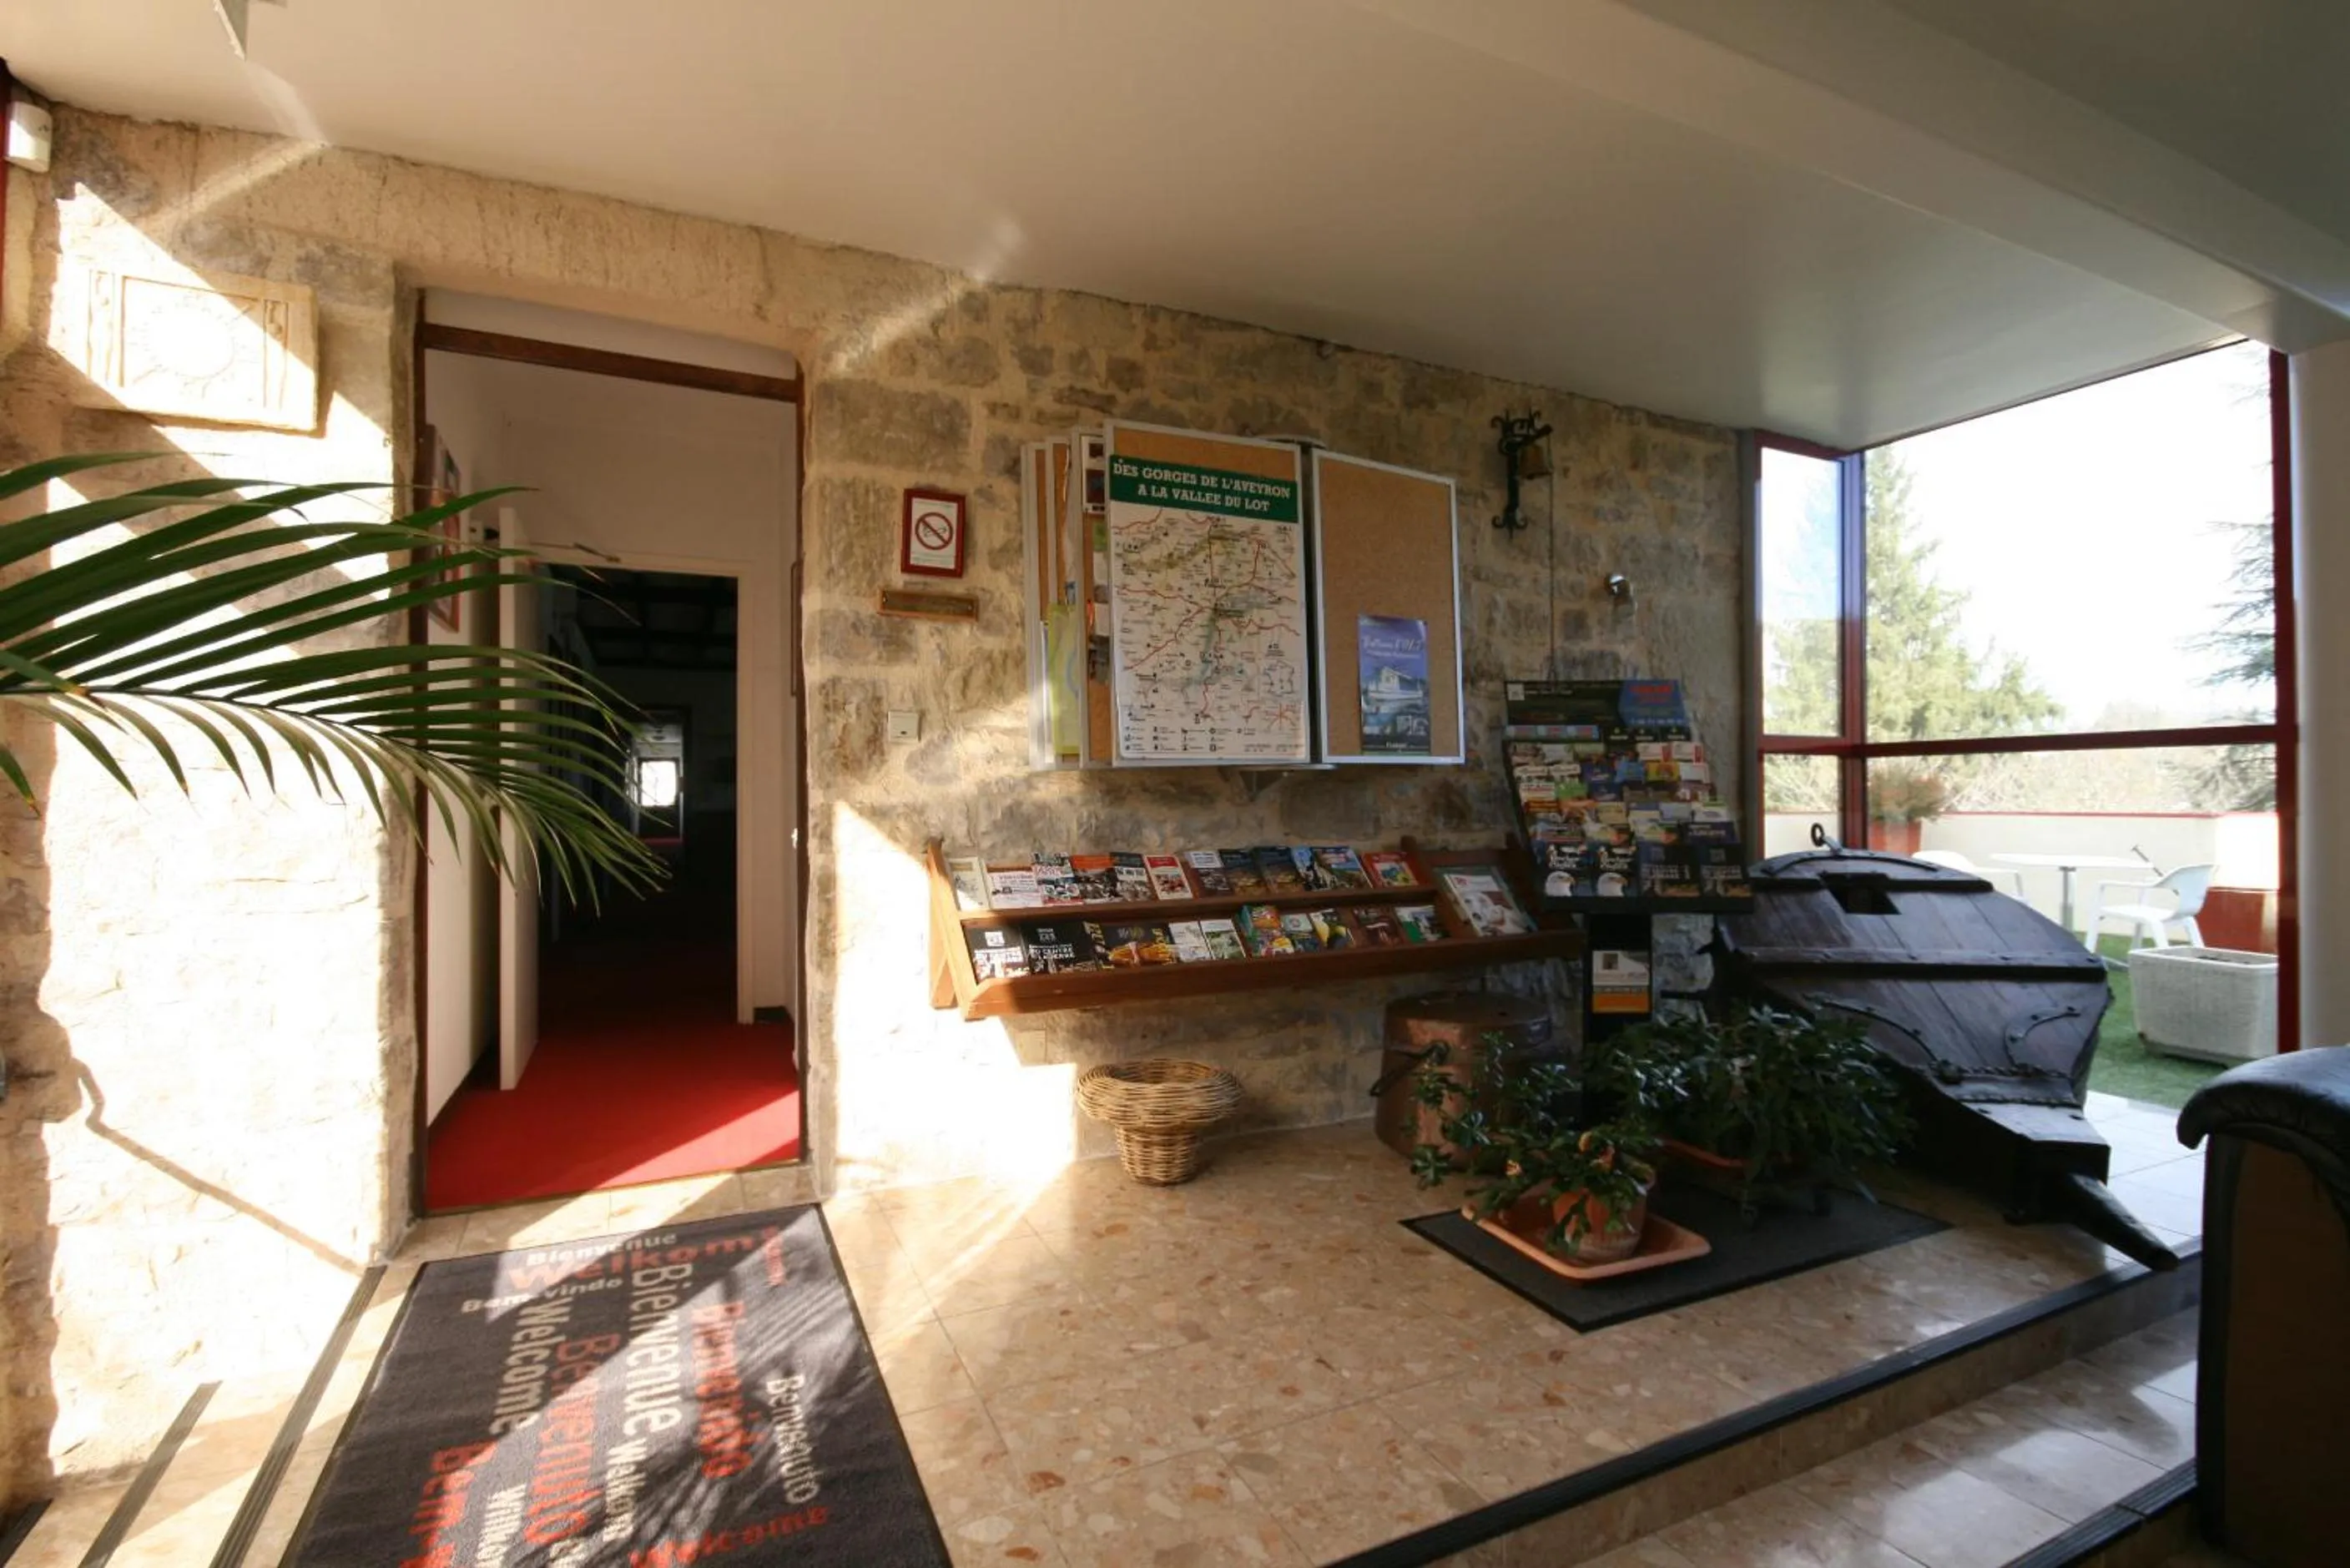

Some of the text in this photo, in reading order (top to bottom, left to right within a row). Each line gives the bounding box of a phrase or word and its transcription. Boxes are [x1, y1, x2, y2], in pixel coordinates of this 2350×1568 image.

[1113, 462, 1290, 499] DES GORGES DE L'AVEYRON
[1137, 484, 1270, 512] A LA VALLEE DU LOT
[508, 1235, 755, 1289] Welkom
[525, 1233, 678, 1266] Bienvenue
[489, 1296, 574, 1435] Welcome
[623, 1263, 693, 1436] Bienvenue
[691, 1300, 768, 1480] Bienvenido
[523, 1333, 622, 1545] Benvenuto
[766, 1374, 825, 1504] Benvenuto
